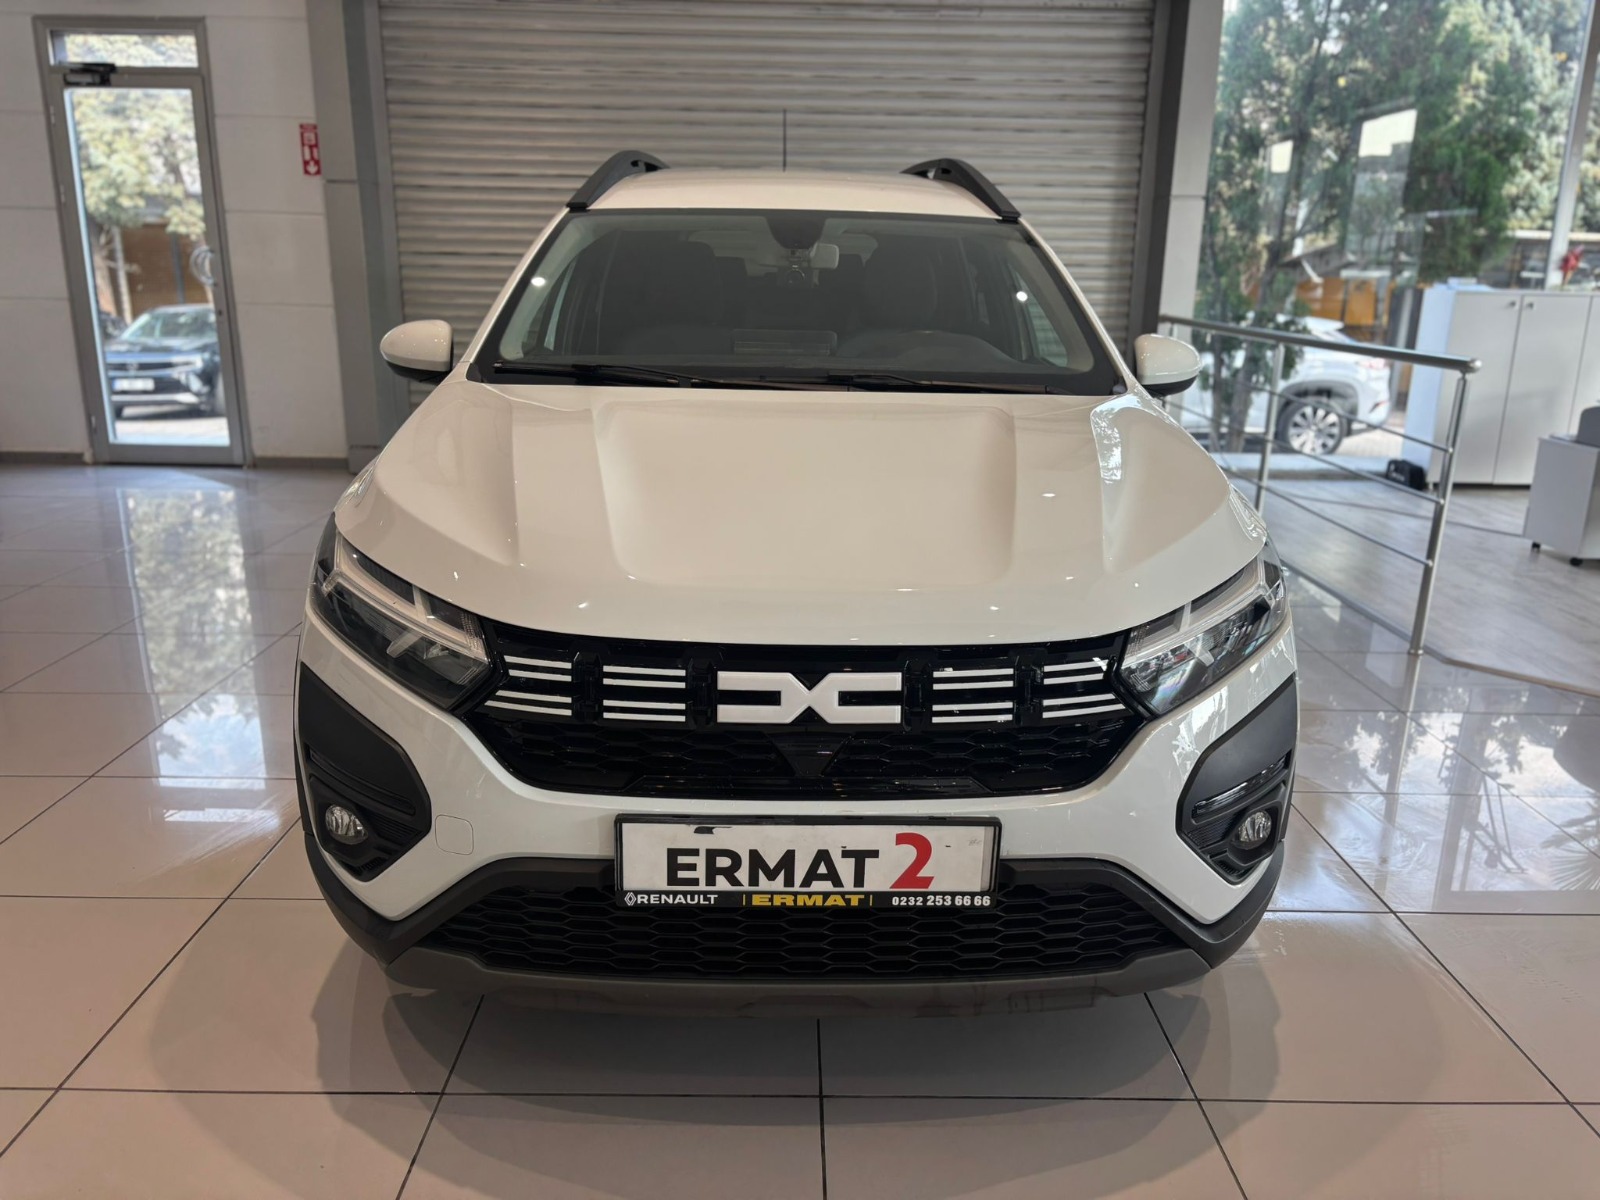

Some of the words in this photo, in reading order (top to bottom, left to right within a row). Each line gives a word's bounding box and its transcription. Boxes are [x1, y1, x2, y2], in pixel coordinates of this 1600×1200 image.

[666, 847, 880, 888] ERMAT
[889, 831, 935, 889] 2
[637, 894, 718, 905] RENAULT
[752, 894, 865, 906] ERMAT
[892, 896, 924, 906] 0232
[926, 895, 952, 906] 253
[954, 895, 972, 906] 66
[973, 895, 991, 907] 66
